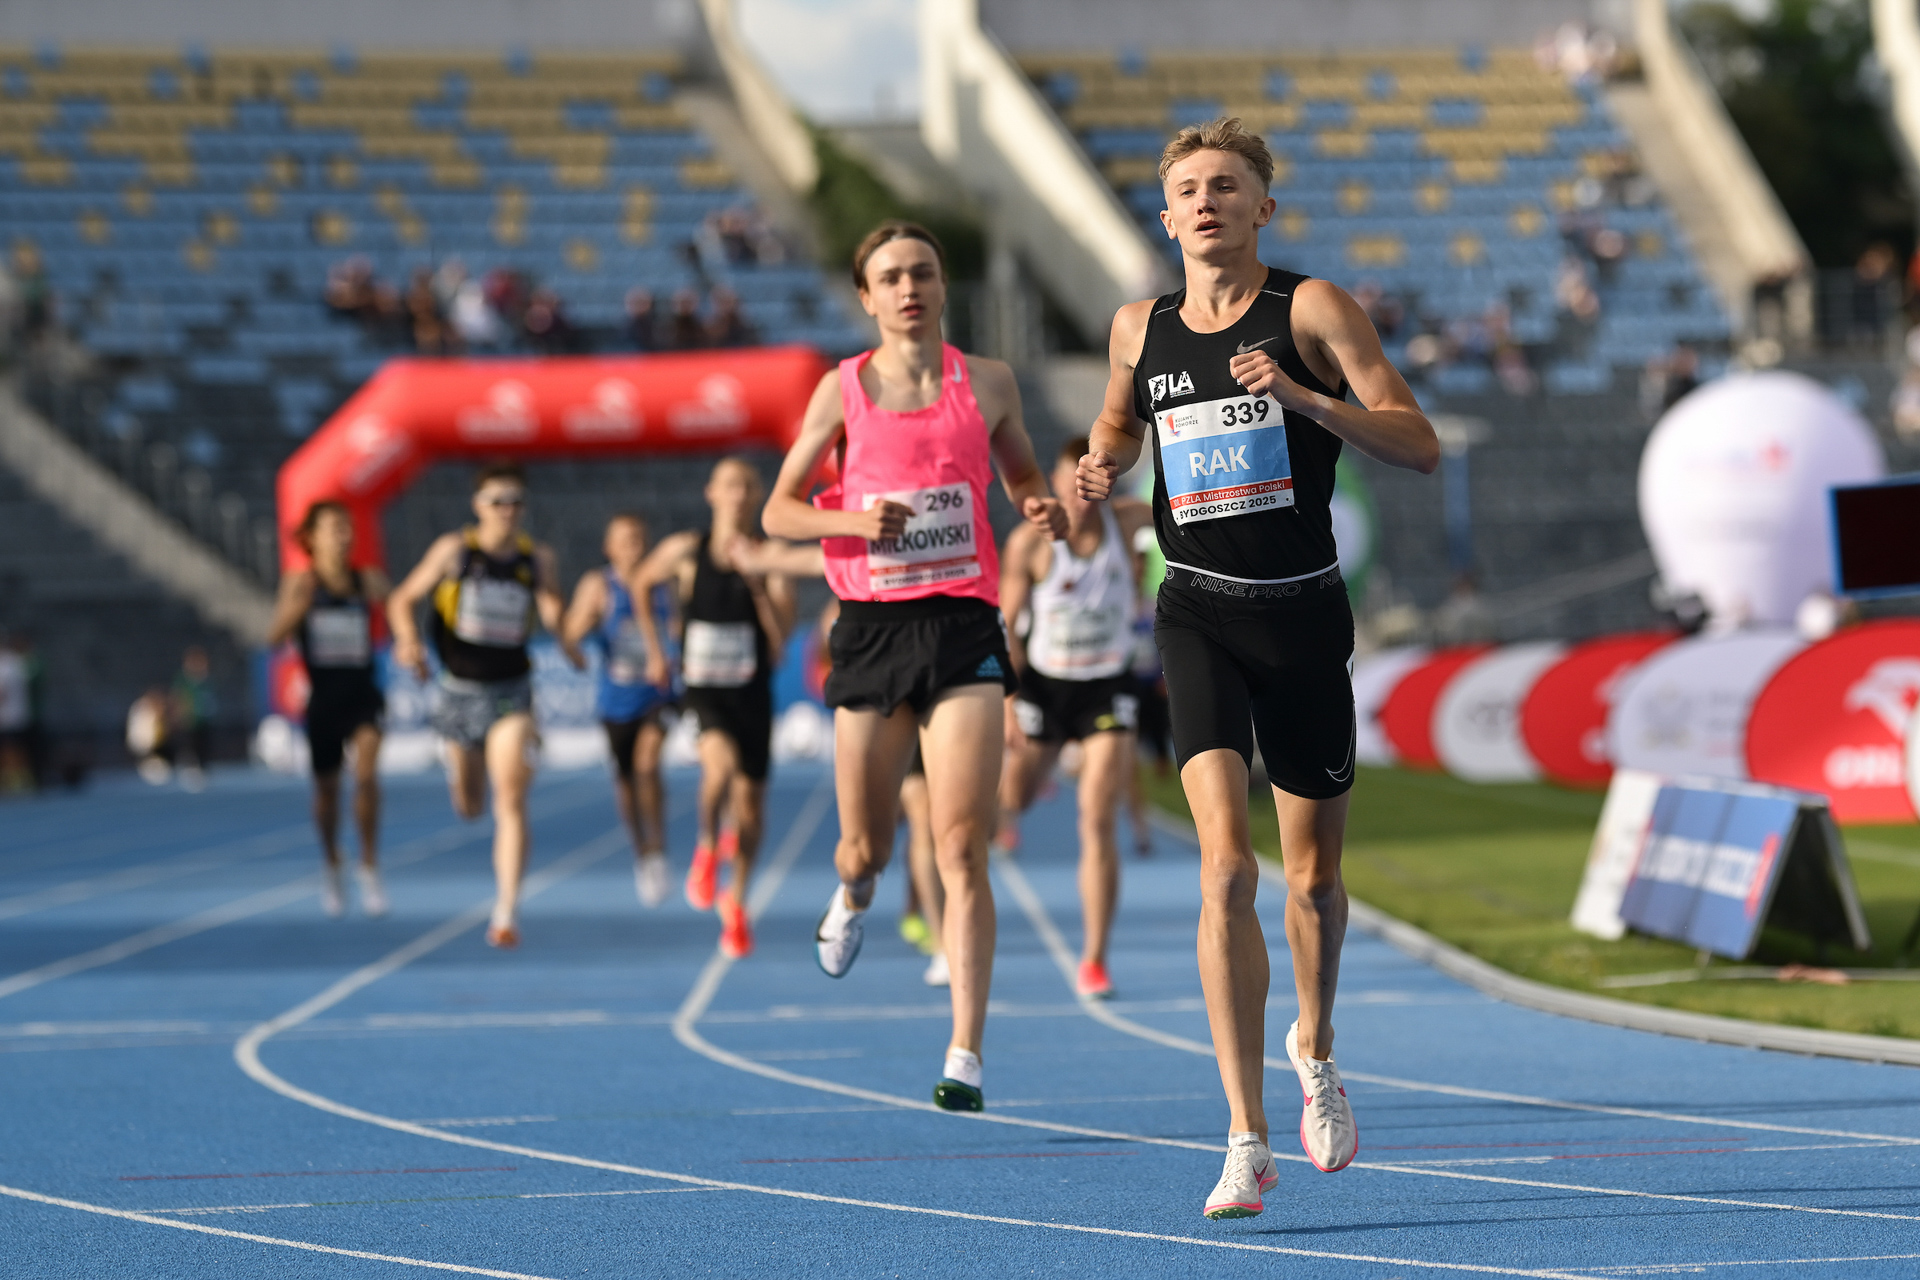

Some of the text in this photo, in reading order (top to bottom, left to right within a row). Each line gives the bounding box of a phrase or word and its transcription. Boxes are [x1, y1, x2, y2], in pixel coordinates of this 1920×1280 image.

[1221, 399, 1269, 427] 339
[1189, 444, 1251, 478] RAK
[925, 490, 964, 512] 296
[1181, 494, 1202, 505] PZLA
[1203, 487, 1258, 502] Mistrzostwa
[1259, 481, 1286, 493] Polski
[1180, 495, 1277, 520] BYDGOSZCZ 2025
[1191, 574, 1301, 599] NIKE PRO
